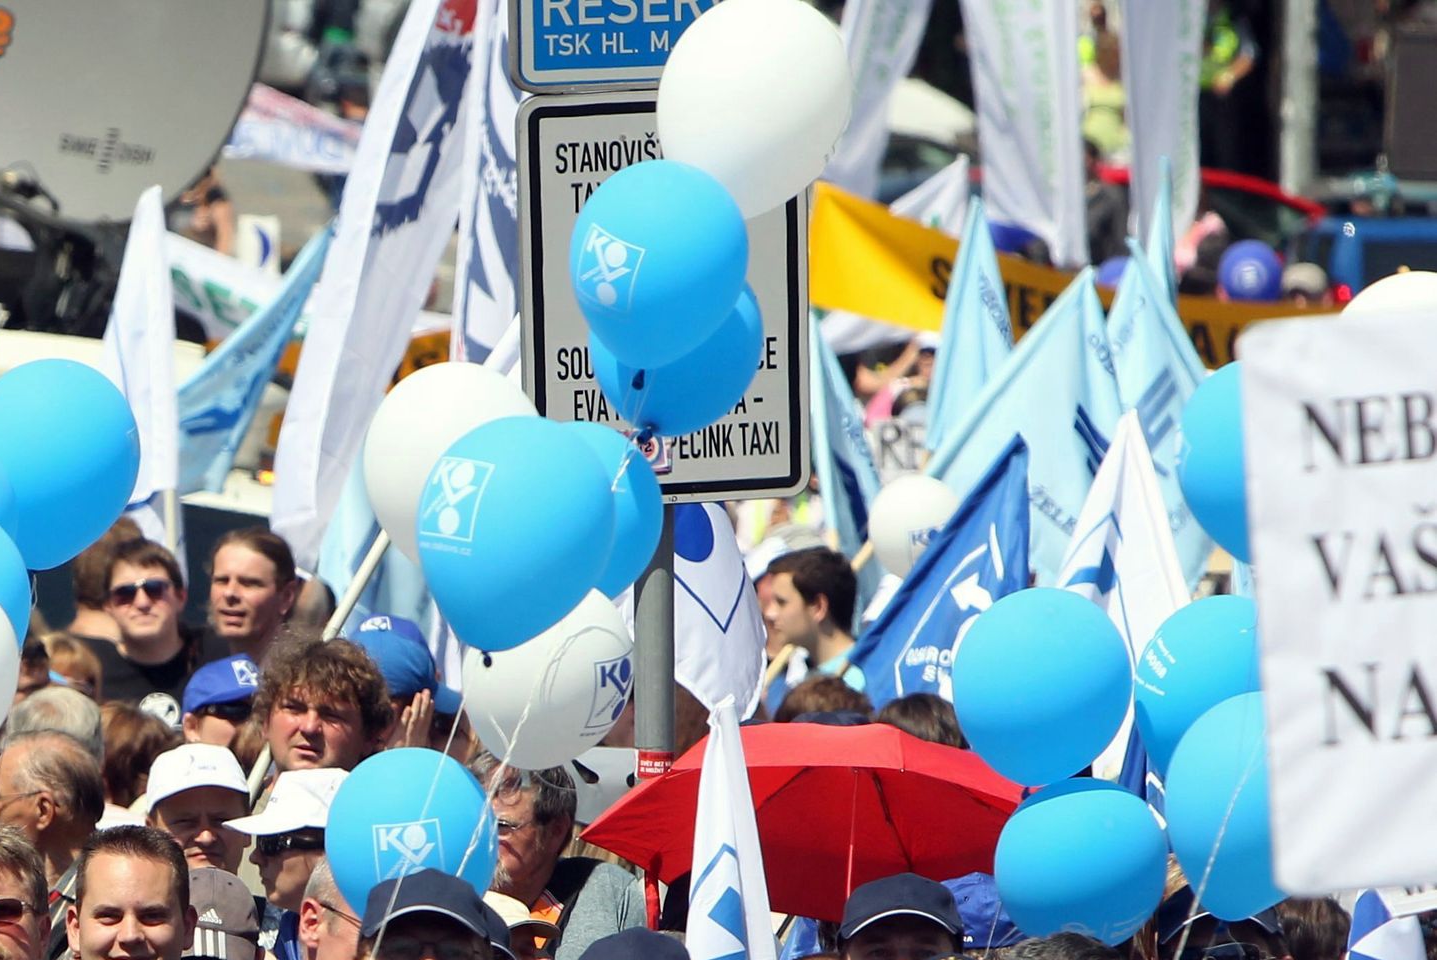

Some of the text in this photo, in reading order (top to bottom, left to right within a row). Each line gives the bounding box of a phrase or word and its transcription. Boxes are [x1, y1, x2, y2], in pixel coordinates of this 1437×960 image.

[542, 0, 718, 26] RESER
[544, 33, 591, 56] TSK
[602, 31, 639, 54] HL.
[555, 132, 664, 174] STANOVIŠ
[556, 346, 595, 381] SOU
[573, 389, 610, 422] EVA
[738, 420, 781, 457] TAXI
